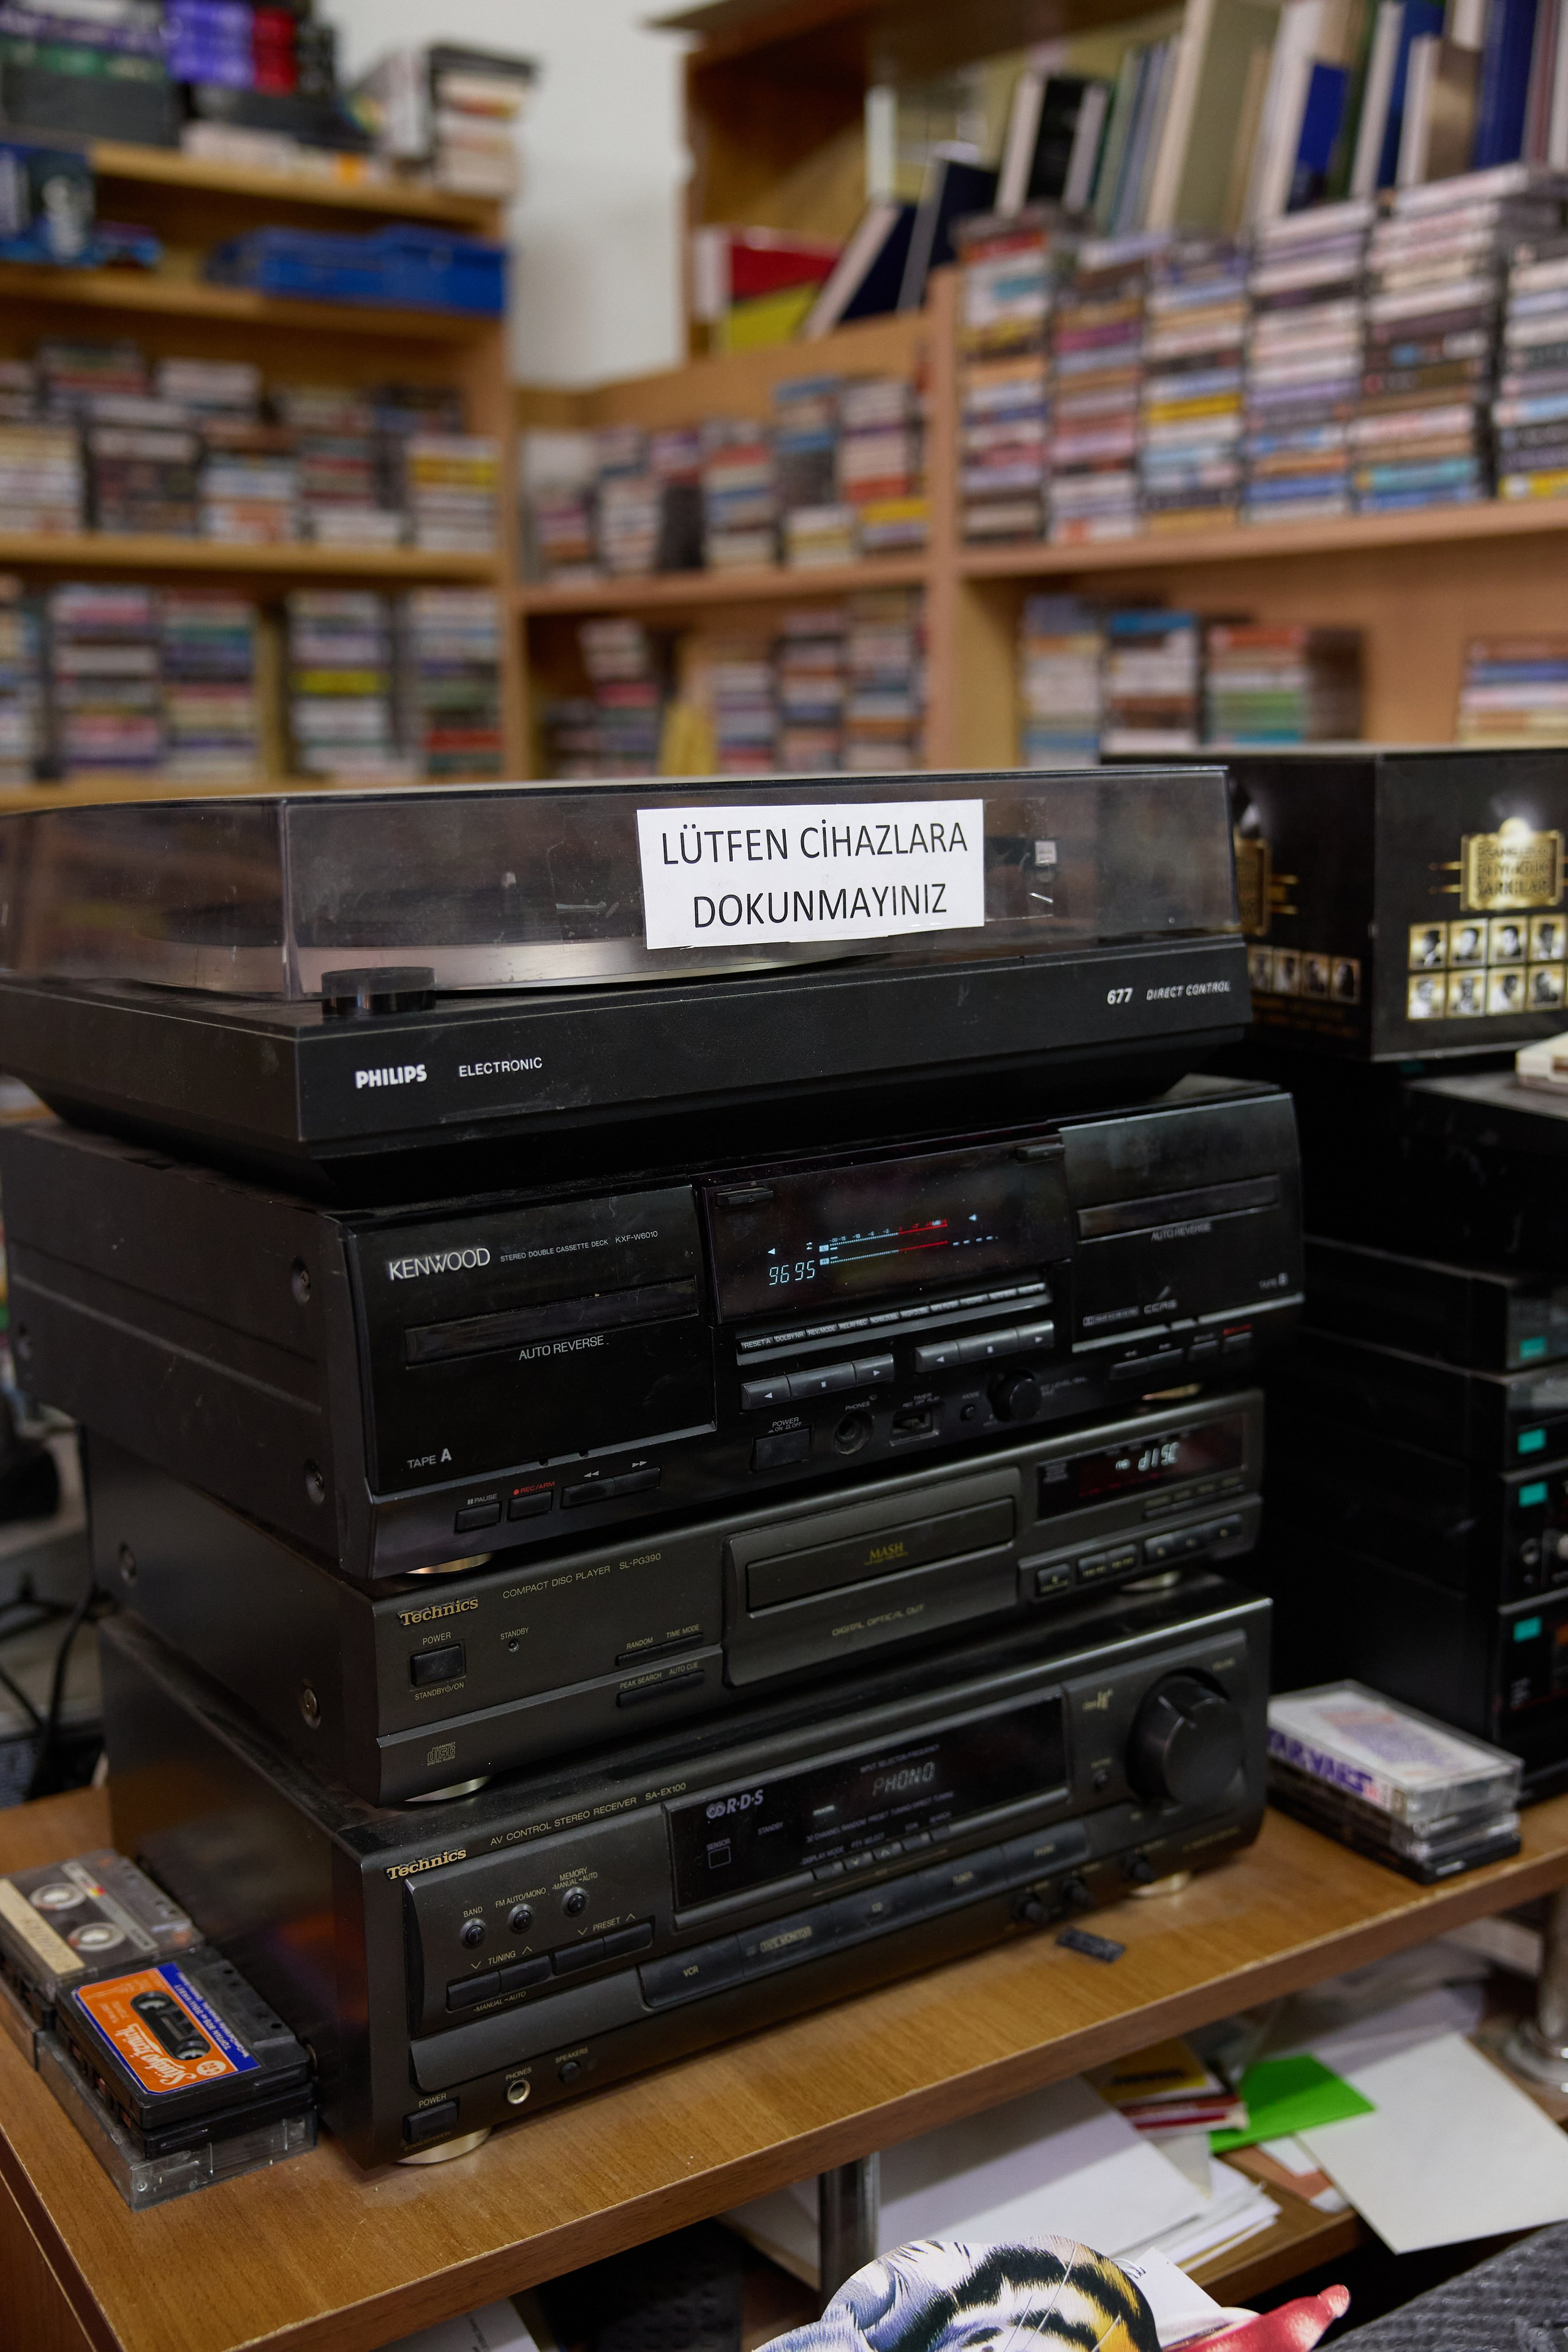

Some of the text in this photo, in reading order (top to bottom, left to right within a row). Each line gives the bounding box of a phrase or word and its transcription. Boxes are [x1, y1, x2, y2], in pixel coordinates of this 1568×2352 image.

[662, 820, 968, 865] LÜTFEN CİHAZLARA
[695, 883, 947, 928] DOKUNMAYINIZ
[1107, 980, 1231, 1005] 677 DIRECT CONTROL
[355, 1057, 543, 1089] PHILIPS ELECTRONIC
[1151, 1227, 1174, 1242] AUTO
[388, 1231, 658, 1281] KENWOOD STEREO DOUBLE CASSETTE DECK KXF-W6010
[519, 1335, 605, 1360] AUTO REVERSE
[744, 1340, 765, 1349] RESET
[775, 1334, 794, 1343] DOLBY
[845, 1401, 870, 1411] PHONES
[772, 1416, 799, 1428] POWER
[407, 1448, 452, 1469] TAPE A
[474, 1480, 556, 1504] PAUSE REC/ARM
[870, 1540, 903, 1559] MASH
[502, 1553, 662, 1599] COMPACT DISC PLAYER SL-PG390
[399, 1597, 479, 1626] Technics
[832, 1623, 864, 1636] DIGITAL
[866, 1610, 905, 1626] OPTICAL
[422, 1627, 529, 1646] POWER STANDBY
[626, 1624, 700, 1649] RANDOM TIME MODE
[620, 1661, 699, 1689] PEAK SEARCH AUTO CUE
[872, 1761, 935, 1797] PHONO
[490, 1782, 687, 1846] AV CONTROL STEREO RECEIVER SA-EX100
[706, 1838, 731, 1850] SENSOR
[386, 1848, 467, 1880] Technics
[559, 1867, 587, 1882] MEMORY
[463, 1887, 546, 1918] BAND FM AUTO/MONO
[592, 1917, 621, 1932] PRESET
[488, 1950, 516, 1965] TUNING
[682, 1965, 699, 1977] VCR
[554, 2047, 589, 2064] SPEAKERS
[505, 2067, 532, 2081] PHONES
[418, 2093, 447, 2108] POWER
